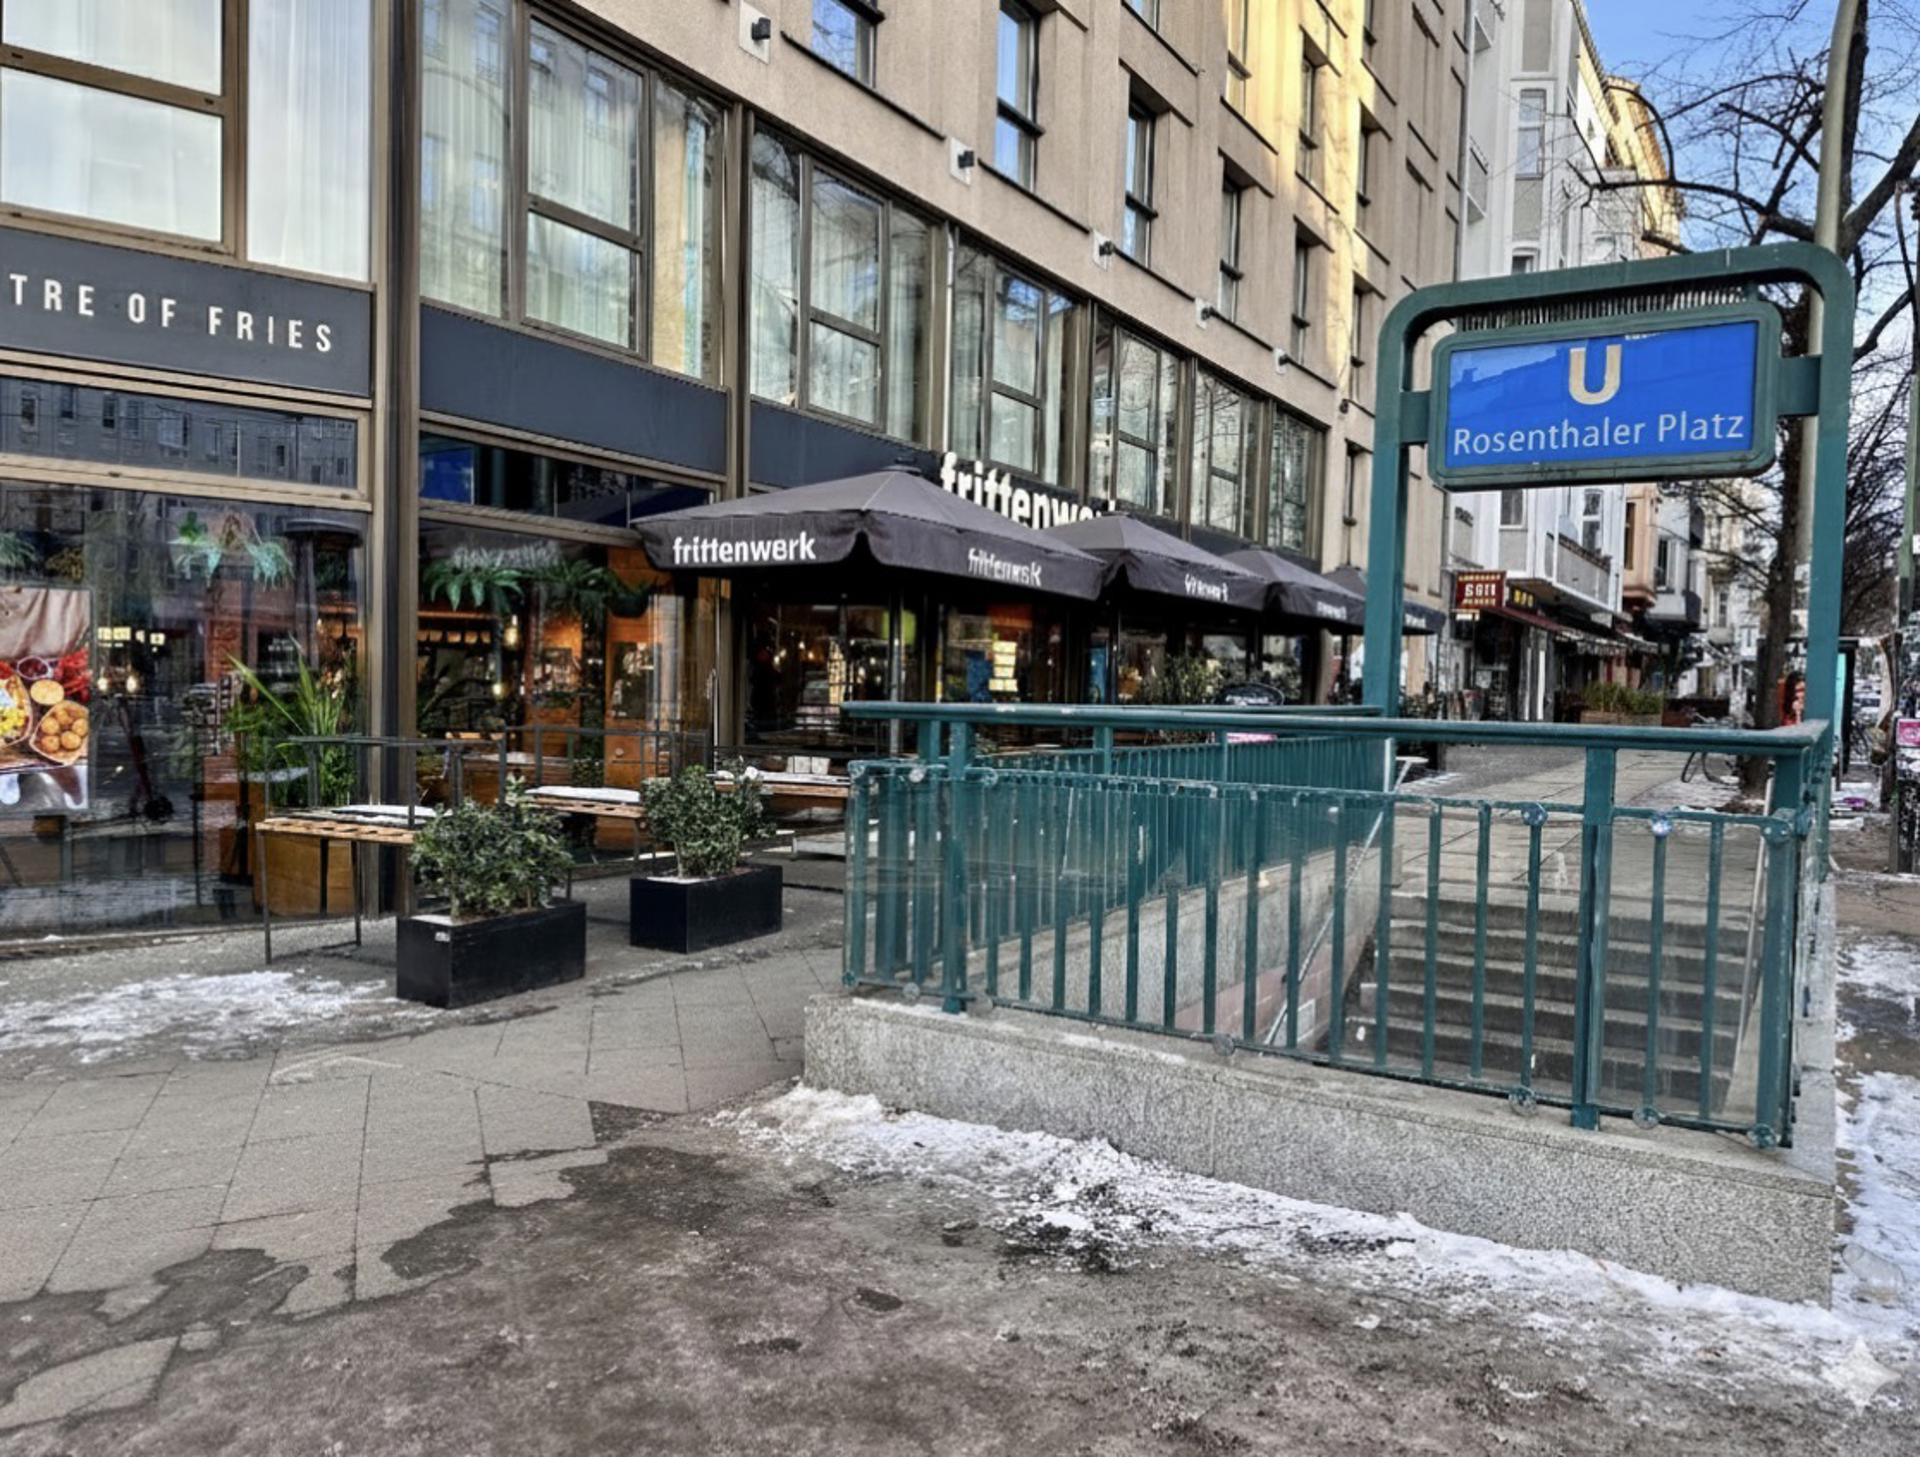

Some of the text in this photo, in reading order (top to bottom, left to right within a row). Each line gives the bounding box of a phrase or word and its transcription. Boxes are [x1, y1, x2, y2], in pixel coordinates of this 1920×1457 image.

[9, 273, 332, 352] TRE OF FRIES
[1568, 343, 1622, 405] U
[1453, 410, 1744, 456] Rosenthaler Platz
[940, 451, 1115, 530] frittenw
[673, 530, 817, 565] frittenwerk
